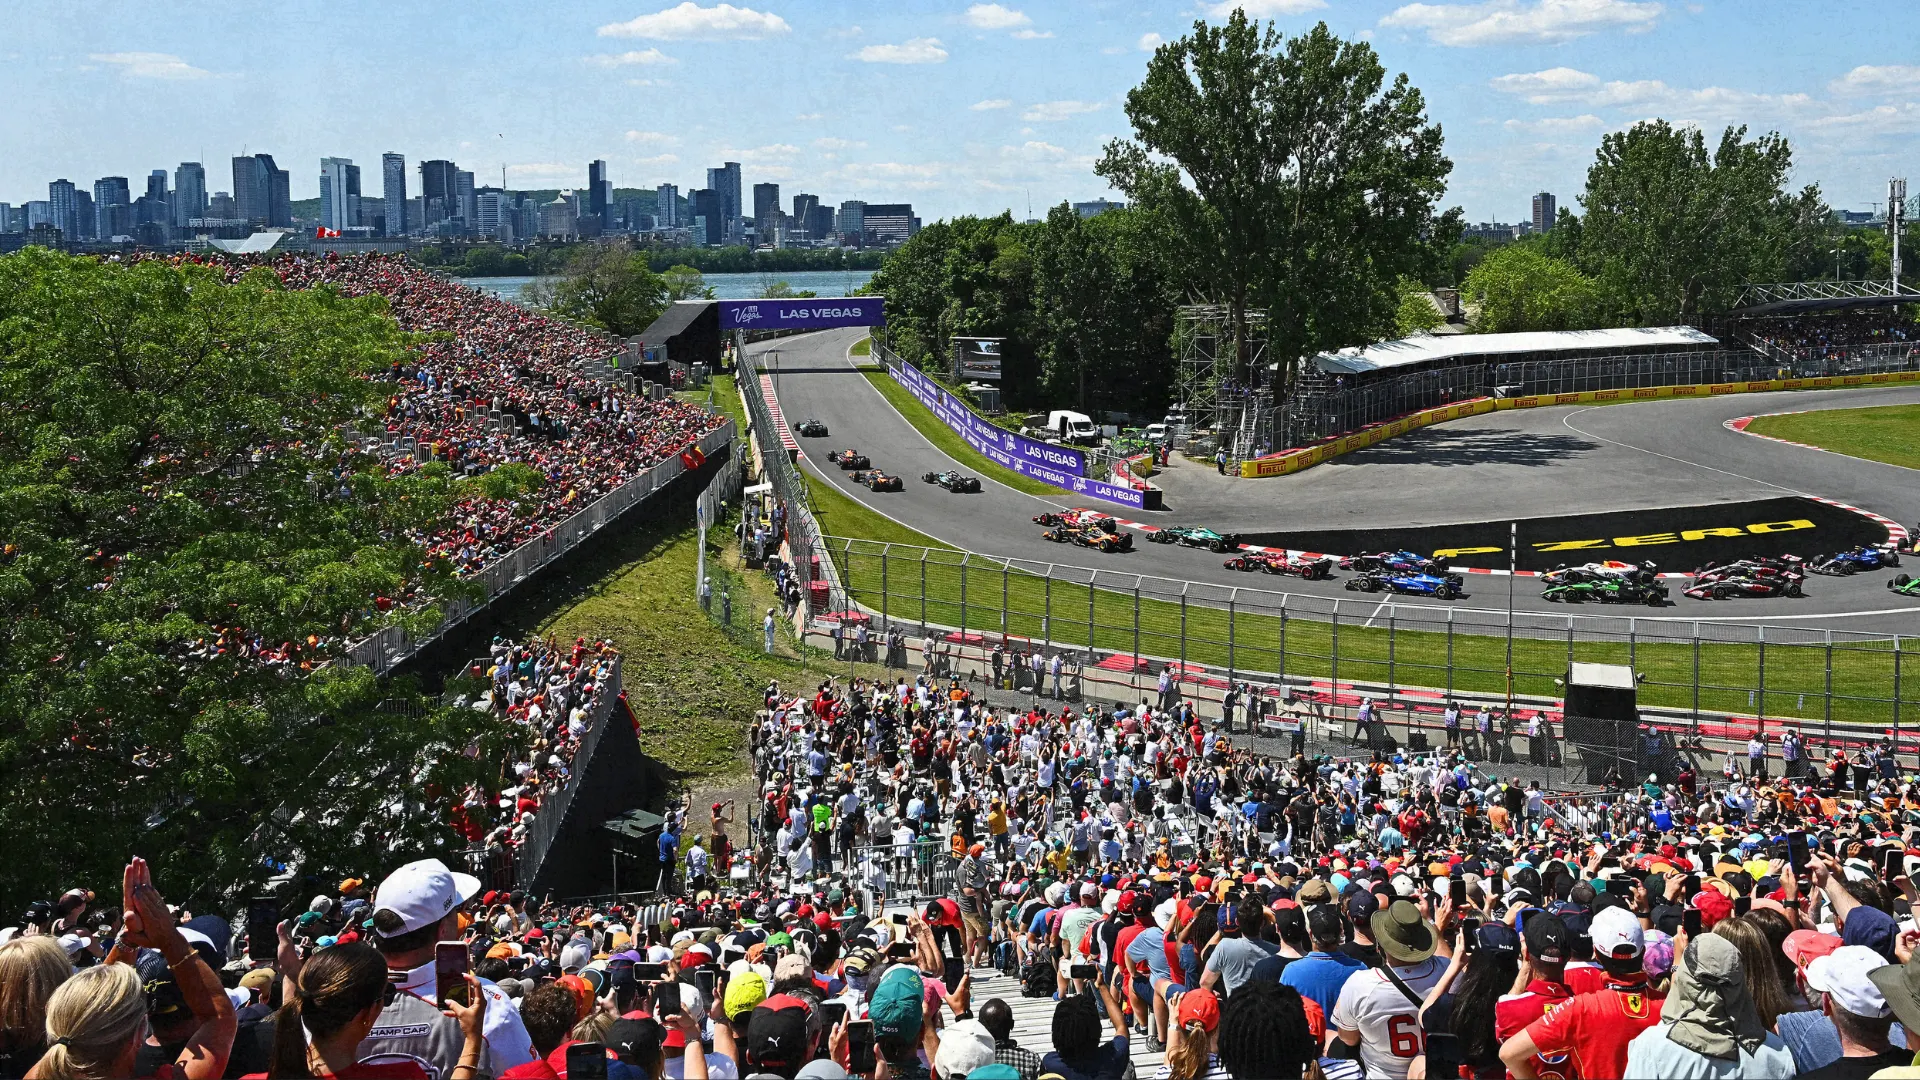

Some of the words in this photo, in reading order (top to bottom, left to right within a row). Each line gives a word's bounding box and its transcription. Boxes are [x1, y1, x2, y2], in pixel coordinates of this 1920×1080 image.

[731, 308, 762, 323] Vegas
[780, 309, 809, 319] LAS
[811, 307, 862, 318] VEGAS
[1556, 394, 1579, 403] PIRELLI
[1595, 391, 1619, 400] PIRELLI
[1634, 388, 1658, 398] PIRELLI
[1514, 398, 1538, 407] PIRELLI
[1024, 444, 1041, 458] LAS
[1042, 449, 1077, 467] VEGAS
[1257, 460, 1286, 474] PIRELLI
[1030, 466, 1041, 477] LAS
[1042, 470, 1065, 484] VEGAS
[1096, 485, 1111, 496] LAS
[1112, 489, 1140, 503] VEGAS
[1532, 519, 1816, 552] ZERO
[1604, 571, 1620, 579] VISA
[1387, 1014, 1427, 1058] 6
